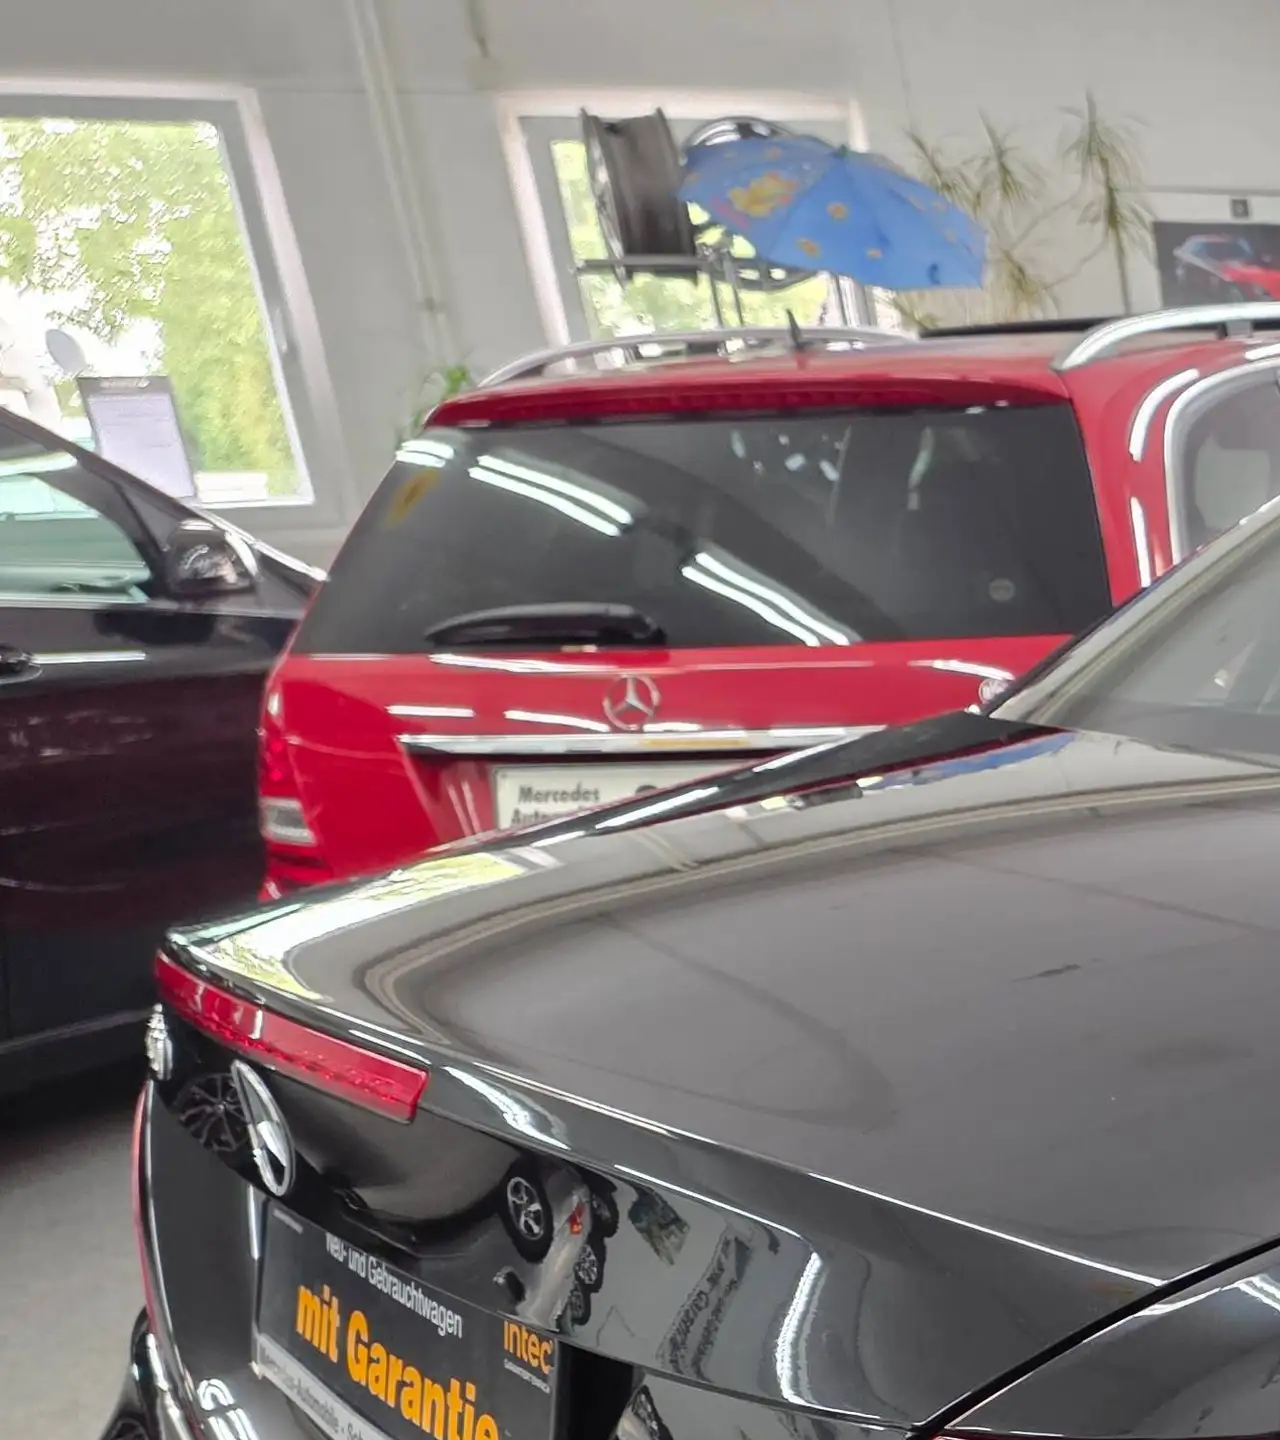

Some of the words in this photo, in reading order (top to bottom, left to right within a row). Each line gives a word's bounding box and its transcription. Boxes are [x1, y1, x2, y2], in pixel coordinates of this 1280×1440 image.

[518, 780, 600, 803] Mercedes
[294, 1283, 340, 1364] mit
[348, 1247, 366, 1279] und
[367, 1255, 463, 1339] Gebrauchtwagen
